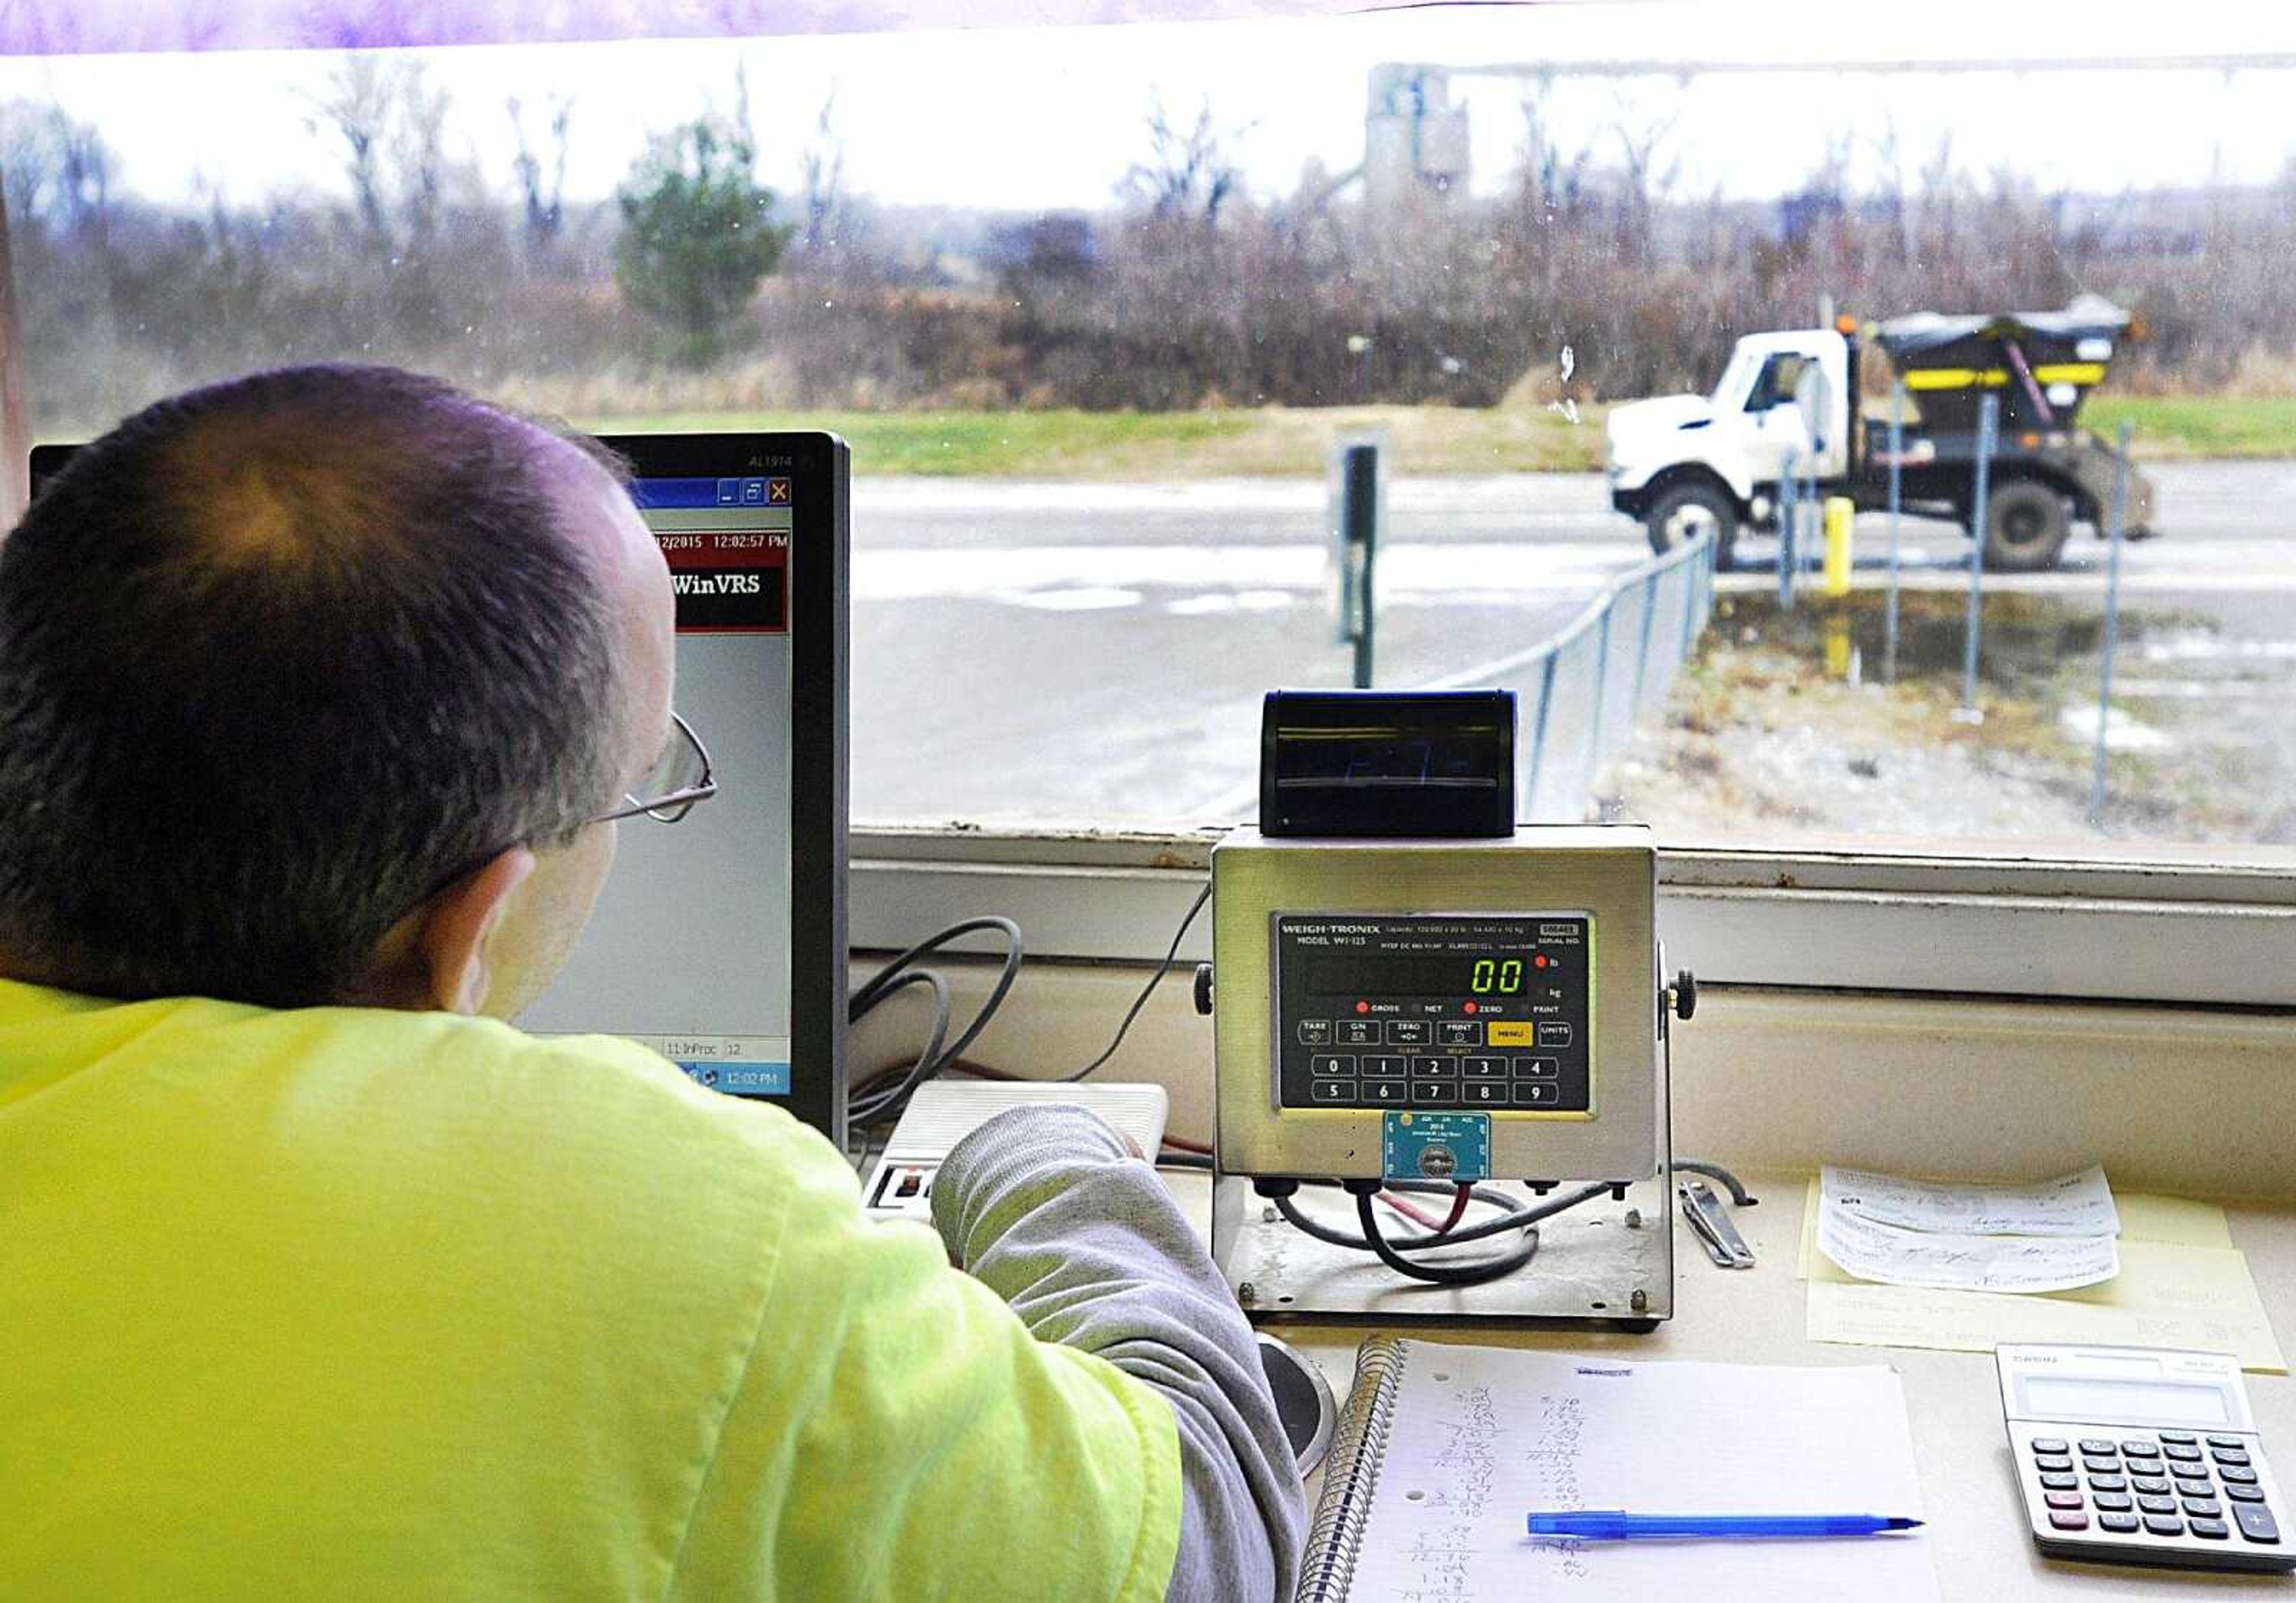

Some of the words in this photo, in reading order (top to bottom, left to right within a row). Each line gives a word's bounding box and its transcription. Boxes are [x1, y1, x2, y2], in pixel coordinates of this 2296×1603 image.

[715, 536, 764, 548] 12:02:57
[768, 536, 788, 547] PM
[670, 574, 761, 594] WinVRS
[1297, 937, 1330, 945] MODEL
[1471, 960, 1522, 993] 00
[1549, 988, 1561, 998] kg
[1329, 1059, 1338, 1072] 0
[1381, 1059, 1386, 1073] 1
[1430, 1060, 1439, 1073] 2
[1480, 1061, 1489, 1073] 3
[1531, 1061, 1540, 1074] 4
[728, 1073, 759, 1084] 12:02
[760, 1074, 777, 1085] PM
[1330, 1084, 1338, 1097] 5
[1379, 1085, 1388, 1098] 6
[1430, 1085, 1439, 1097] 7
[1480, 1086, 1490, 1099] 8
[1531, 1086, 1541, 1100] 9
